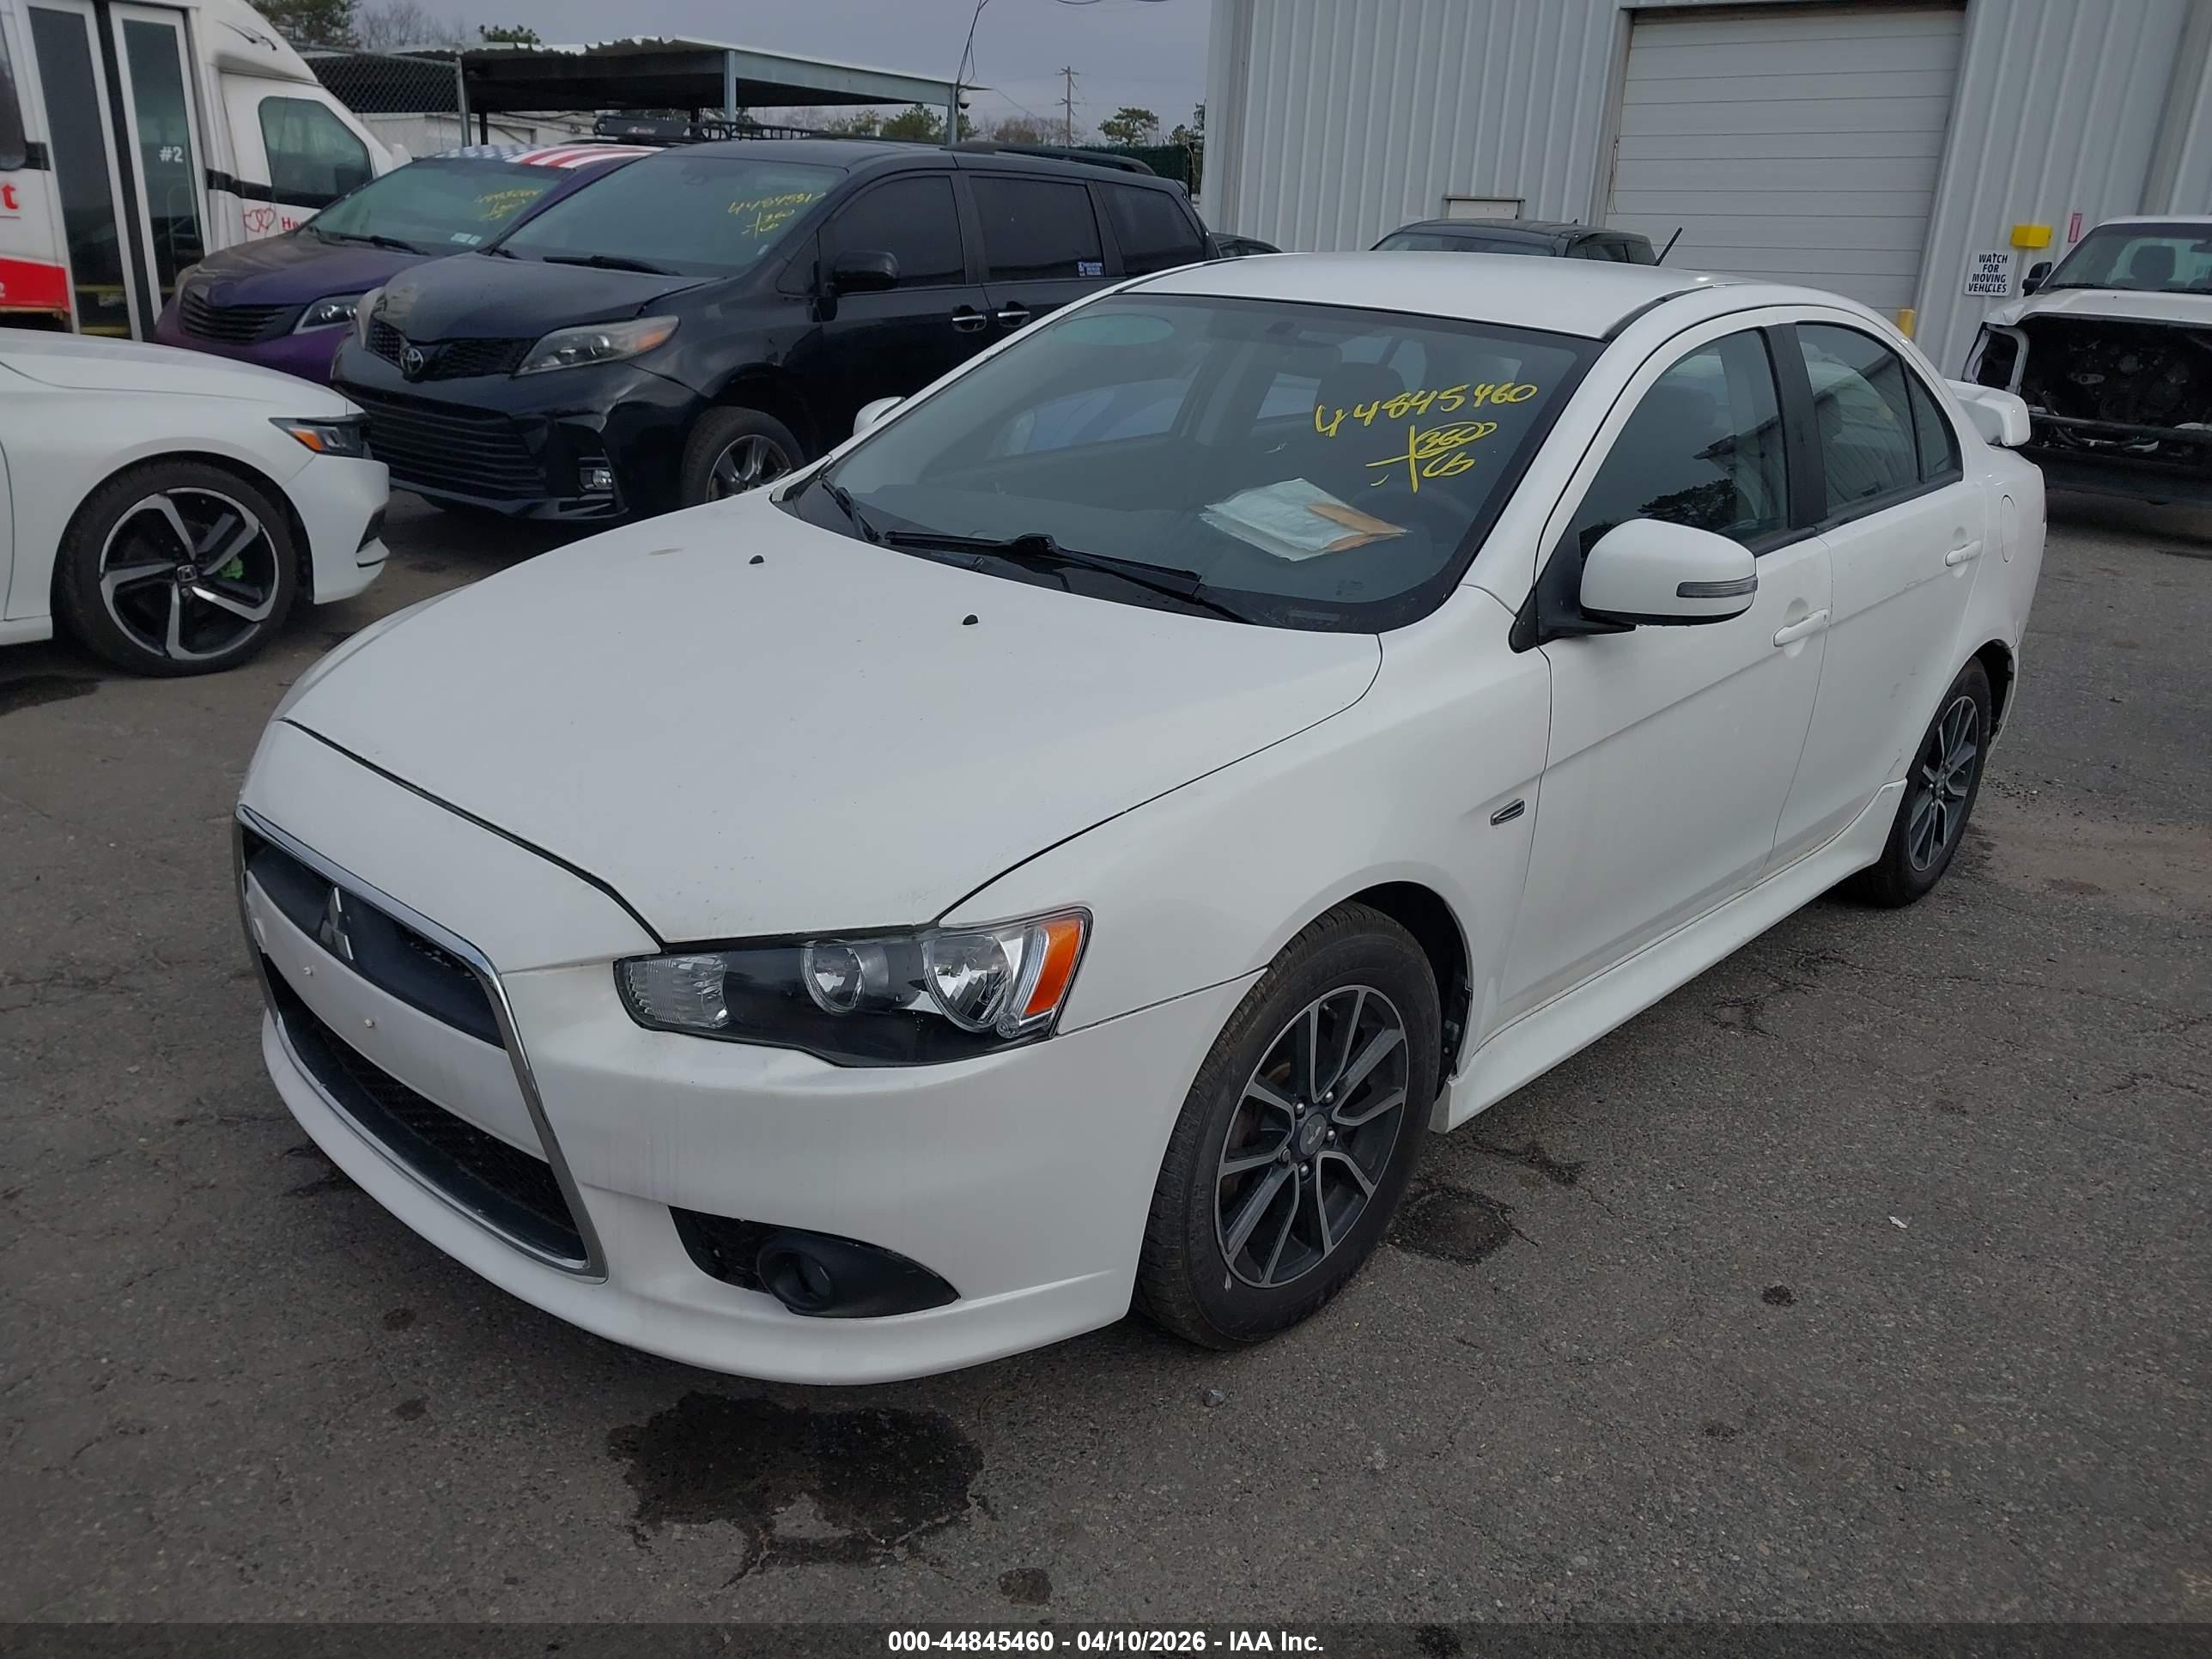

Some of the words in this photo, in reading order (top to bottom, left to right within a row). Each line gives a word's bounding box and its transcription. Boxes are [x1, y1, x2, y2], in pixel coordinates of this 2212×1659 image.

[159, 146, 183, 162] #2
[1978, 253, 2008, 264] WATCH
[1983, 264, 1999, 273] FOR
[1972, 273, 2006, 283] MOVING
[1968, 283, 2007, 294] VEHICLES
